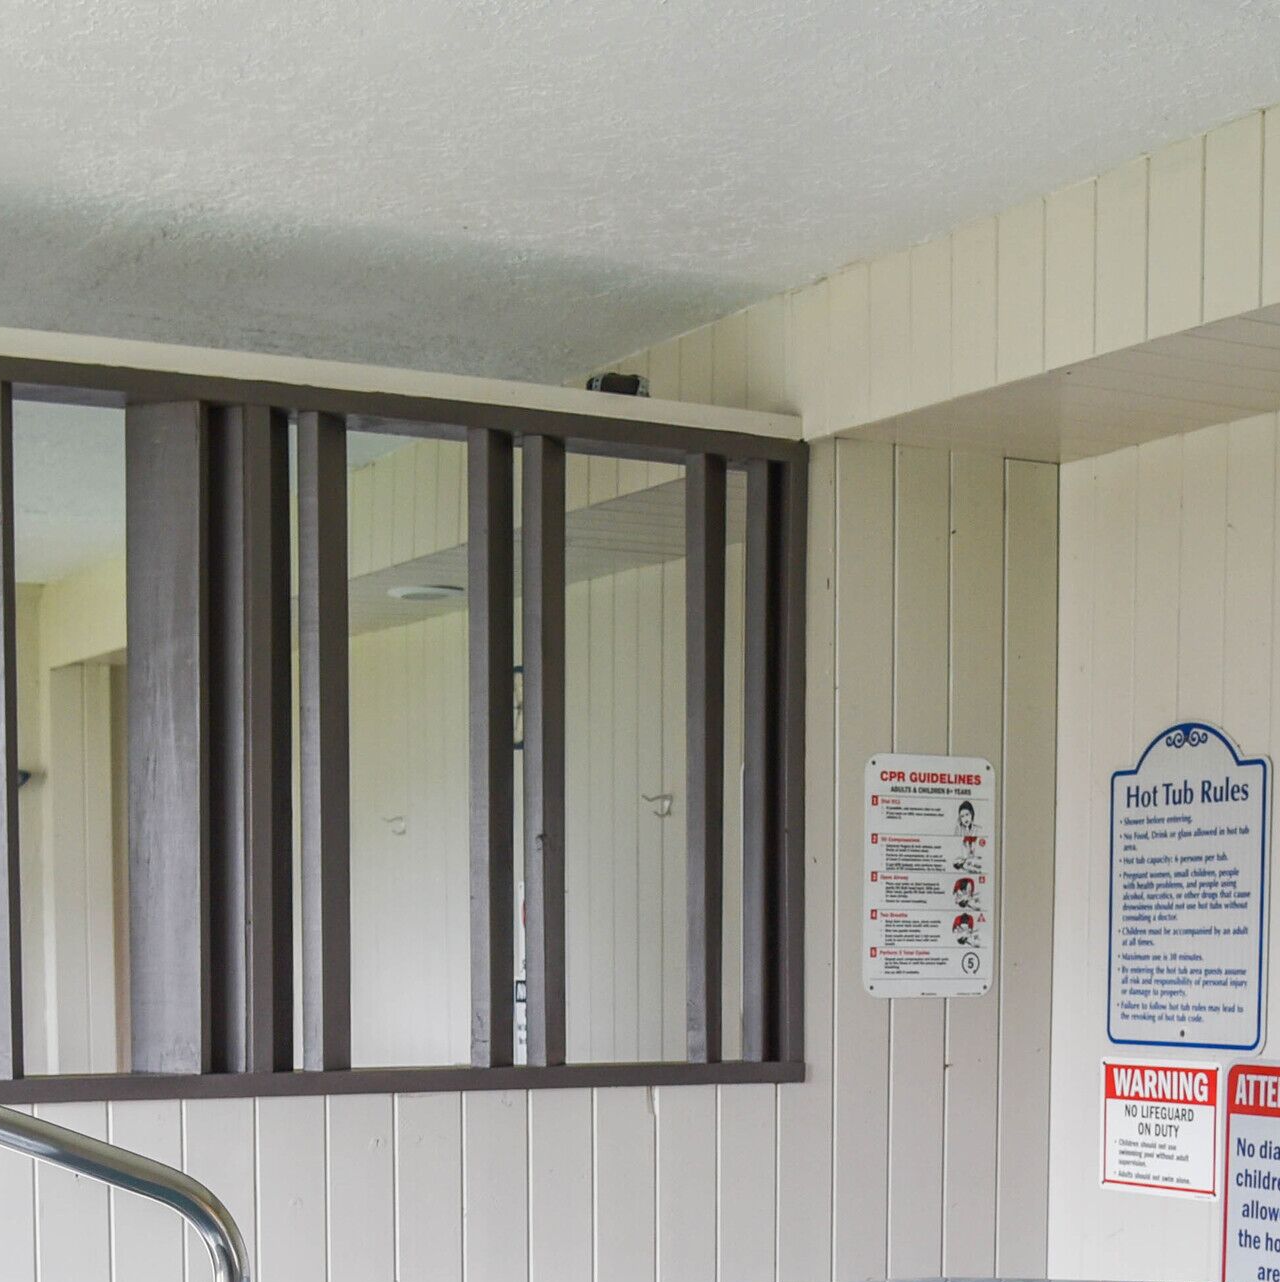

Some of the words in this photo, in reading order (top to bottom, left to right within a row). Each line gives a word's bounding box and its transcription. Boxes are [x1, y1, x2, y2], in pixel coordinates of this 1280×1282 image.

[880, 771, 905, 782] CPR
[909, 772, 981, 785] GUIDELINES
[1126, 786, 1158, 808] Hot
[1162, 780, 1194, 806] Tub
[1201, 777, 1249, 804] Rules
[968, 958, 974, 968] 5
[1113, 1068, 1209, 1102] WARNING
[1125, 1105, 1138, 1118] NO
[1141, 1106, 1194, 1122] LIFEGUARD
[1138, 1122, 1151, 1136] ON
[1154, 1123, 1179, 1138] DUTY
[1236, 1138, 1255, 1159] No
[1238, 1229, 1260, 1250] the
